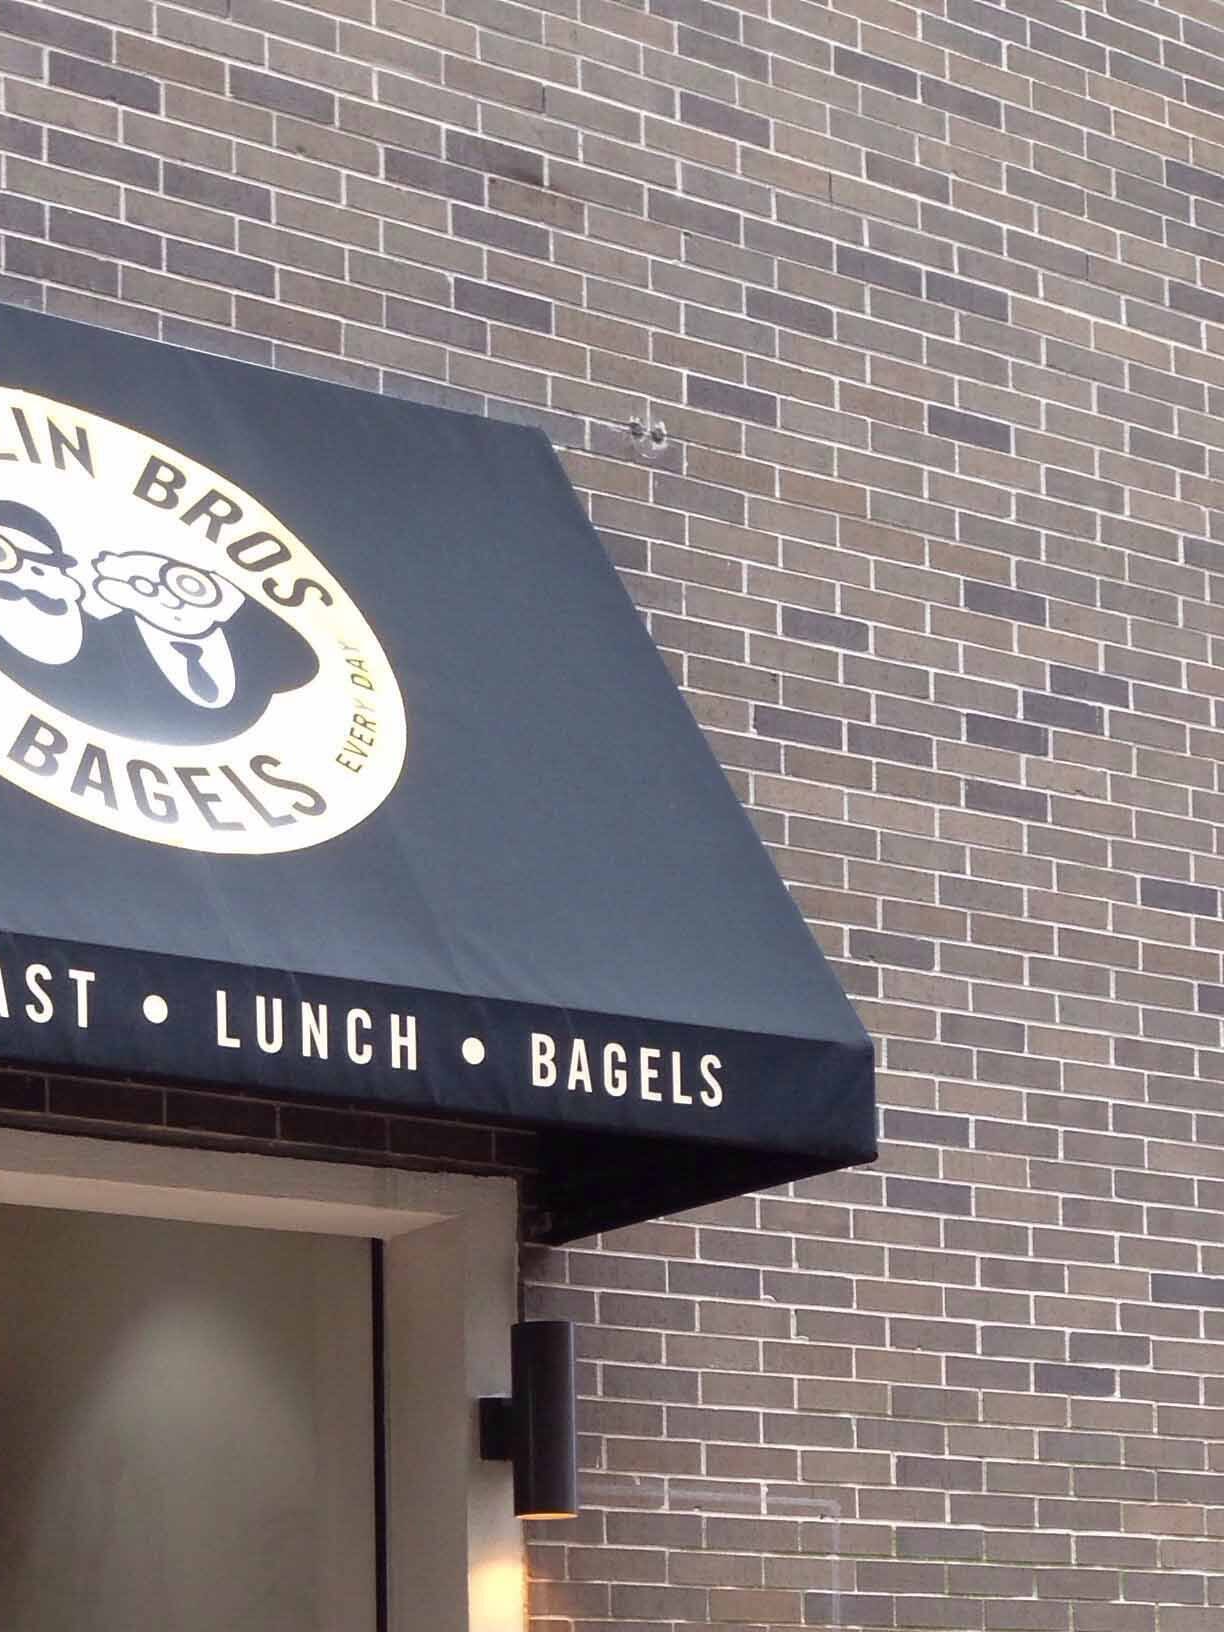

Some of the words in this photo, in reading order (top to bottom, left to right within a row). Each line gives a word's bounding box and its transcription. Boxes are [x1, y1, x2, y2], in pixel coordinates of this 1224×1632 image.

[131, 455, 334, 611] BROS
[338, 640, 375, 691] DAY
[6, 713, 328, 833] BAGELS
[335, 697, 377, 774] EVERY
[216, 989, 418, 1072] LUNCH
[531, 1031, 725, 1108] BAGELS
